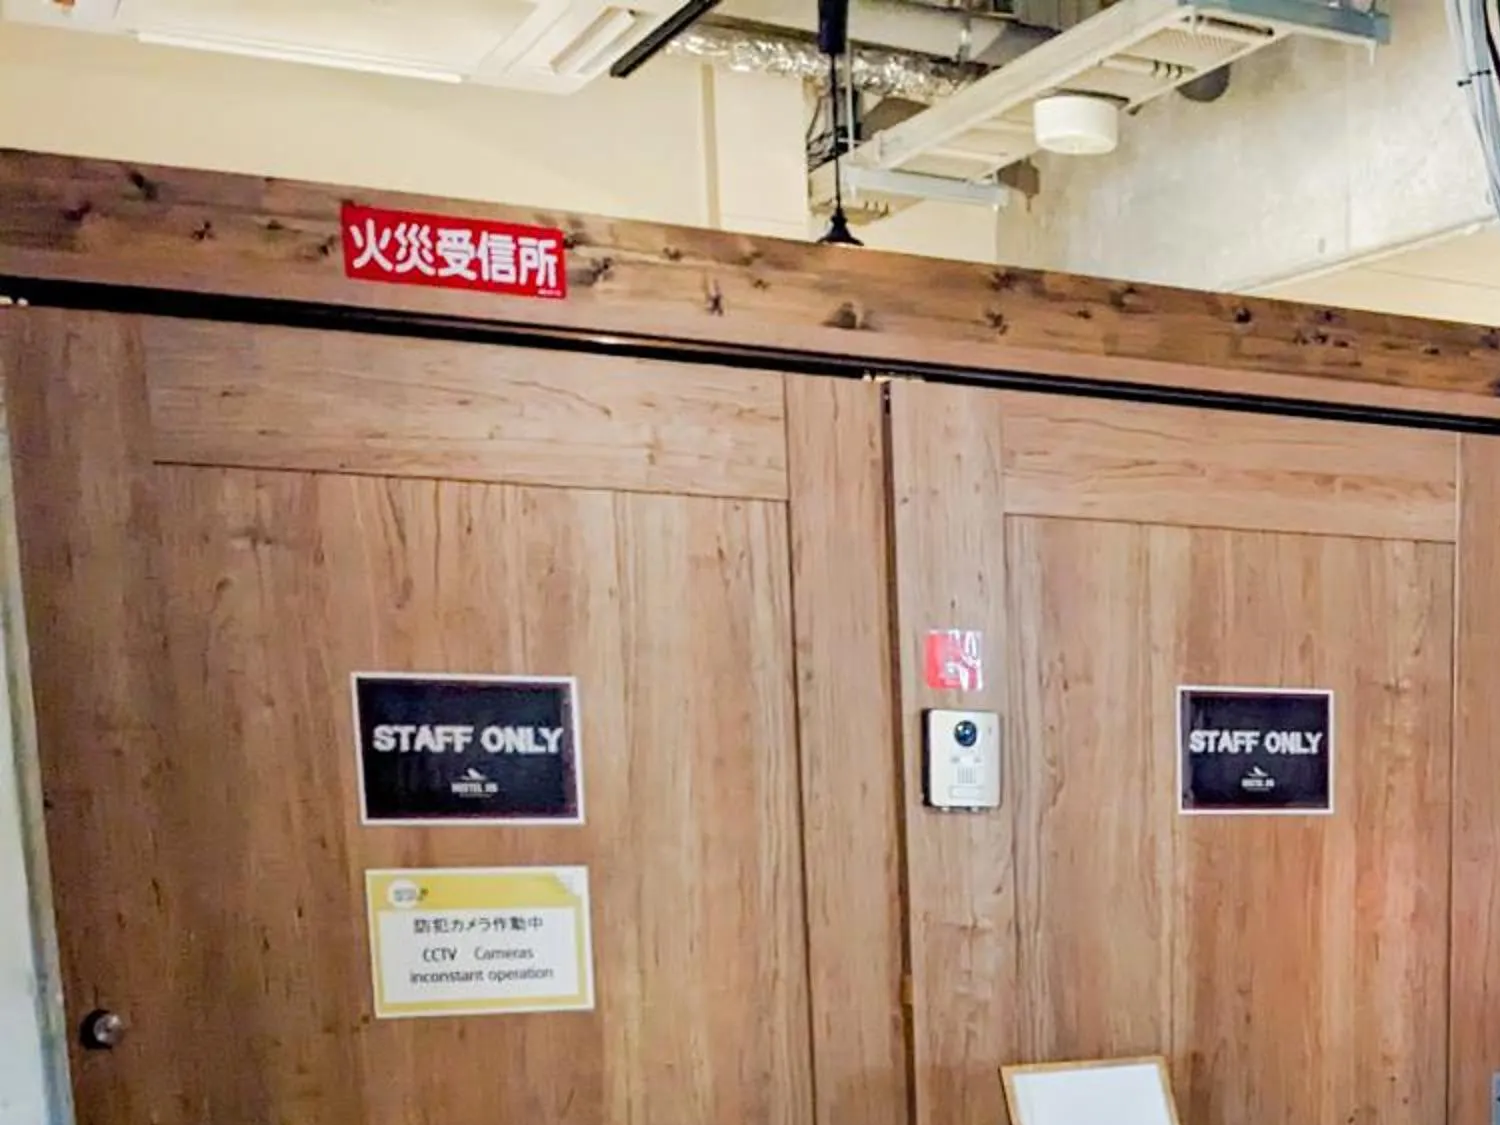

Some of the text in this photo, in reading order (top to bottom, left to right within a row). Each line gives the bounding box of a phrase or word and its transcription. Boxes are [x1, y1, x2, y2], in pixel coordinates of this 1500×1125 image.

[349, 217, 558, 288] 火災受信所
[372, 724, 563, 754] STAFF ONLY
[1189, 729, 1323, 755] STAFF ONLY
[413, 917, 543, 934] 防犯カメラ作動中
[423, 947, 534, 962] CCTV Cameras
[410, 967, 553, 984] inconstant operation
